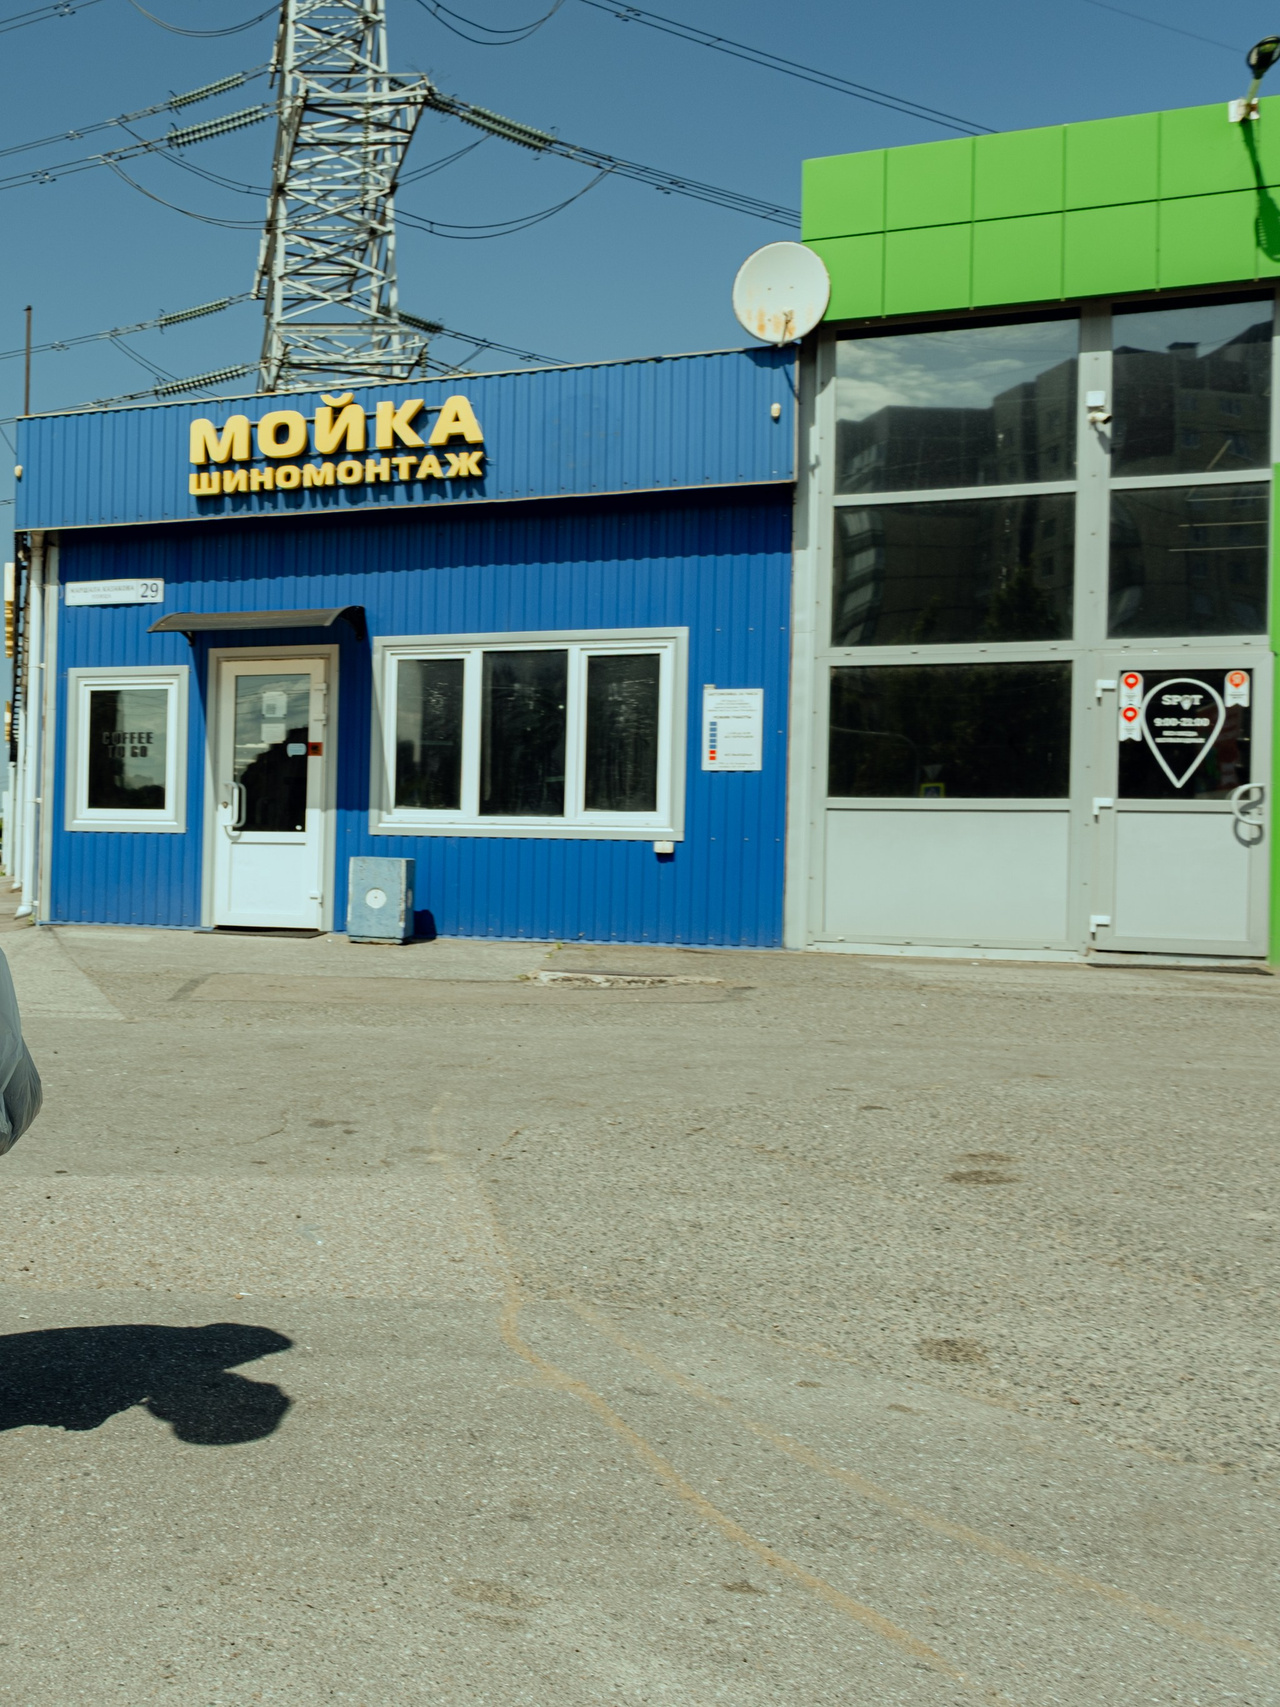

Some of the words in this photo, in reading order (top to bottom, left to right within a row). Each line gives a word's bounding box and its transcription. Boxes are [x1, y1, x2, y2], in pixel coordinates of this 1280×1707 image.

[189, 392, 485, 466] МОЙКА
[189, 451, 484, 497] ШИНОМОНТАЖ
[140, 582, 159, 599] 29
[102, 731, 154, 745] COFFEE
[107, 745, 125, 758] TO
[130, 745, 148, 758] GO
